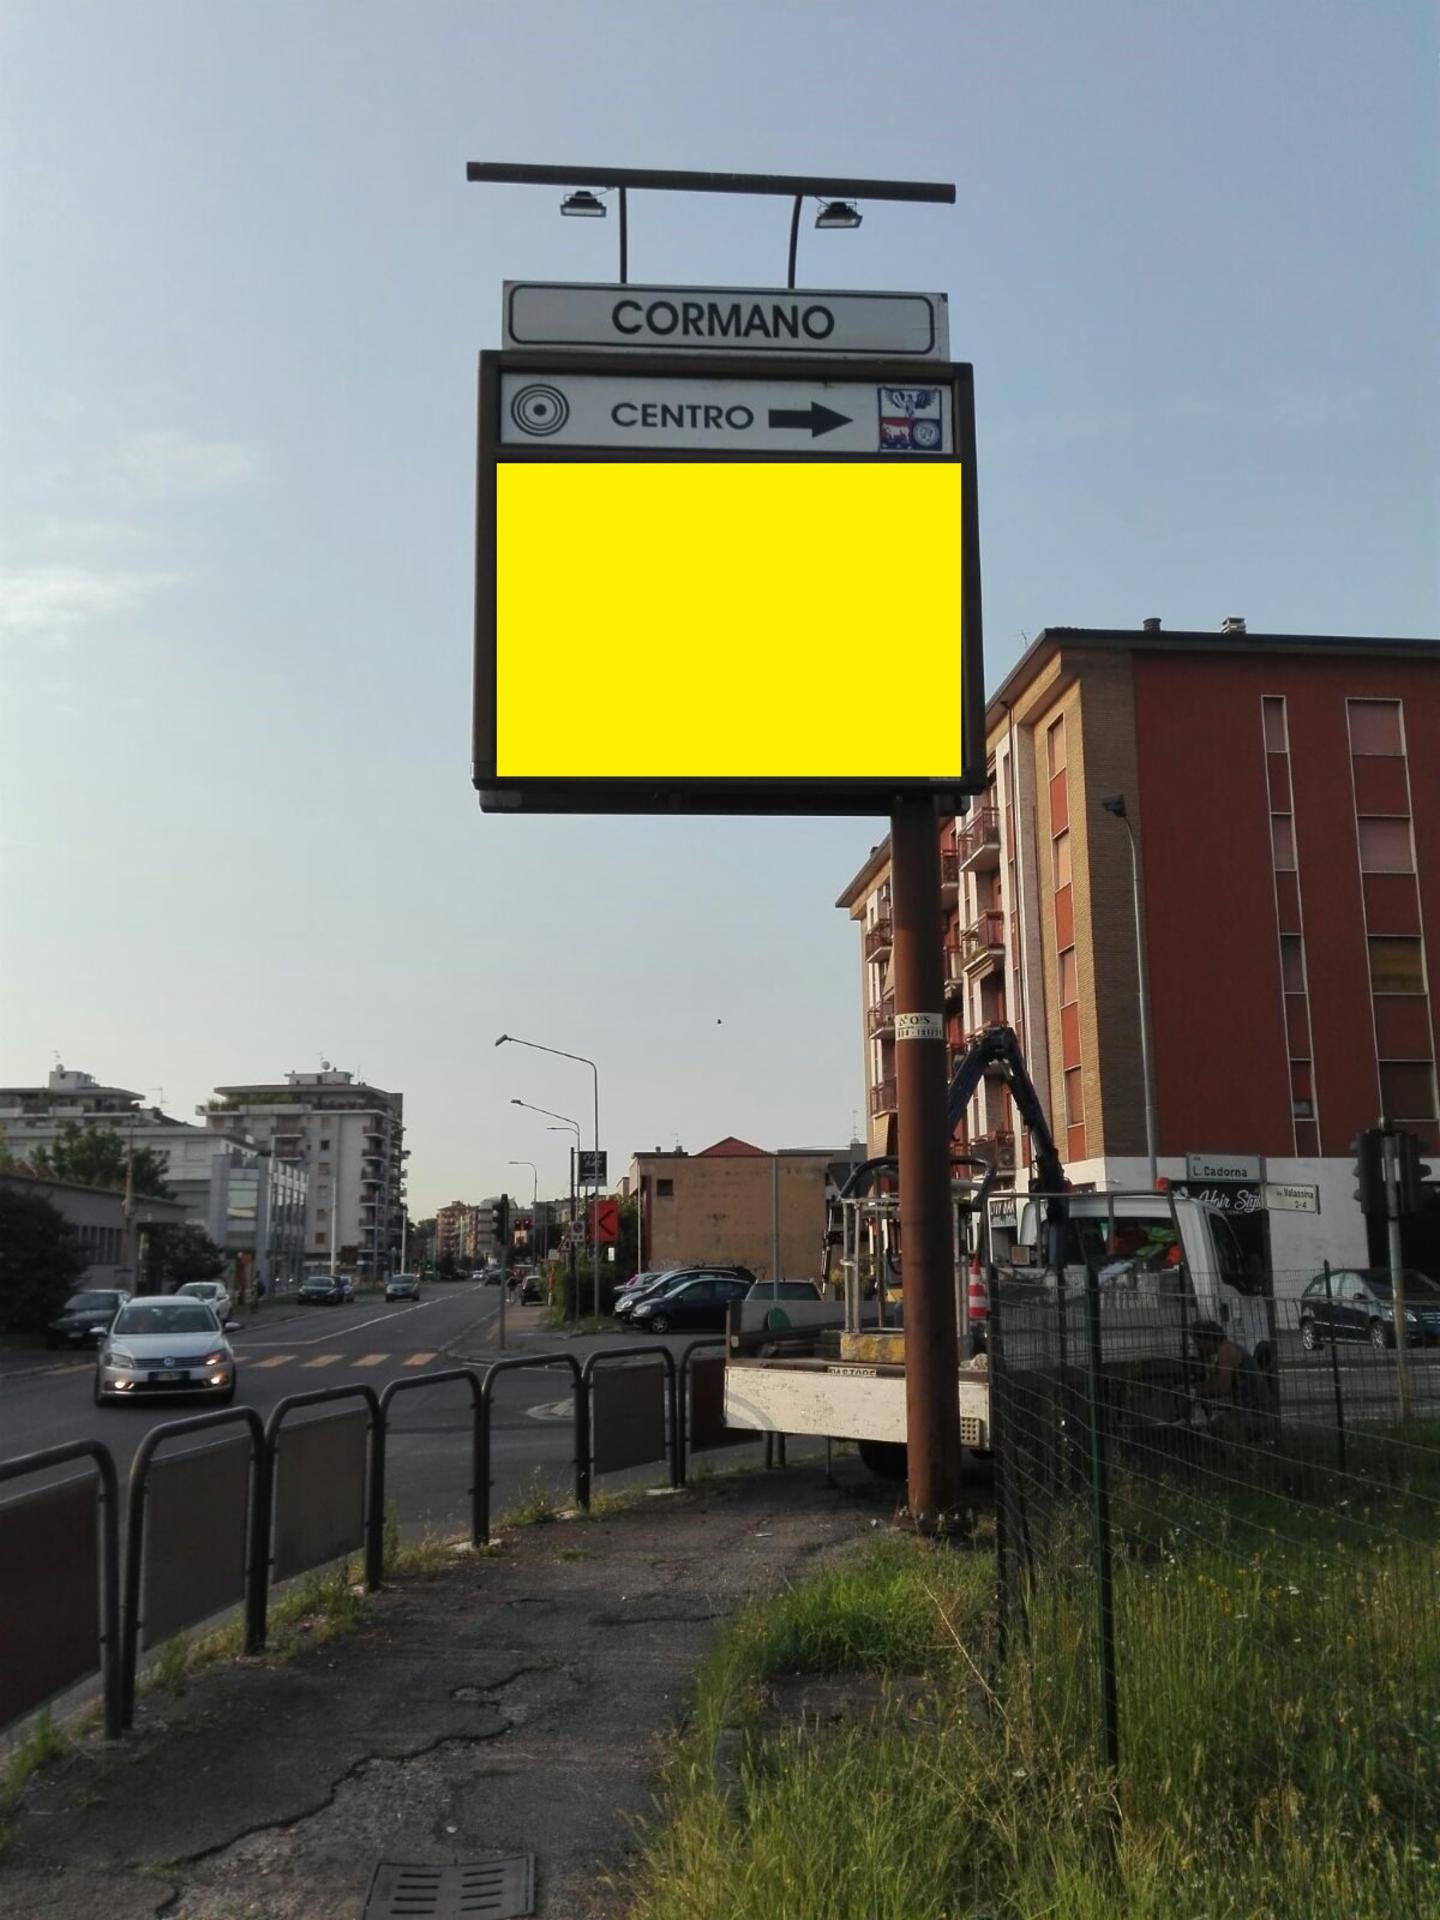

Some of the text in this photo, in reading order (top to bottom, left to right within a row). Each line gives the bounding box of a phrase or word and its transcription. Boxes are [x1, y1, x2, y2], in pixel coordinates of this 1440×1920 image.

[612, 300, 834, 340] CORMANO
[611, 402, 754, 430] CENTRO
[1203, 1165, 1248, 1177] Cadorna
